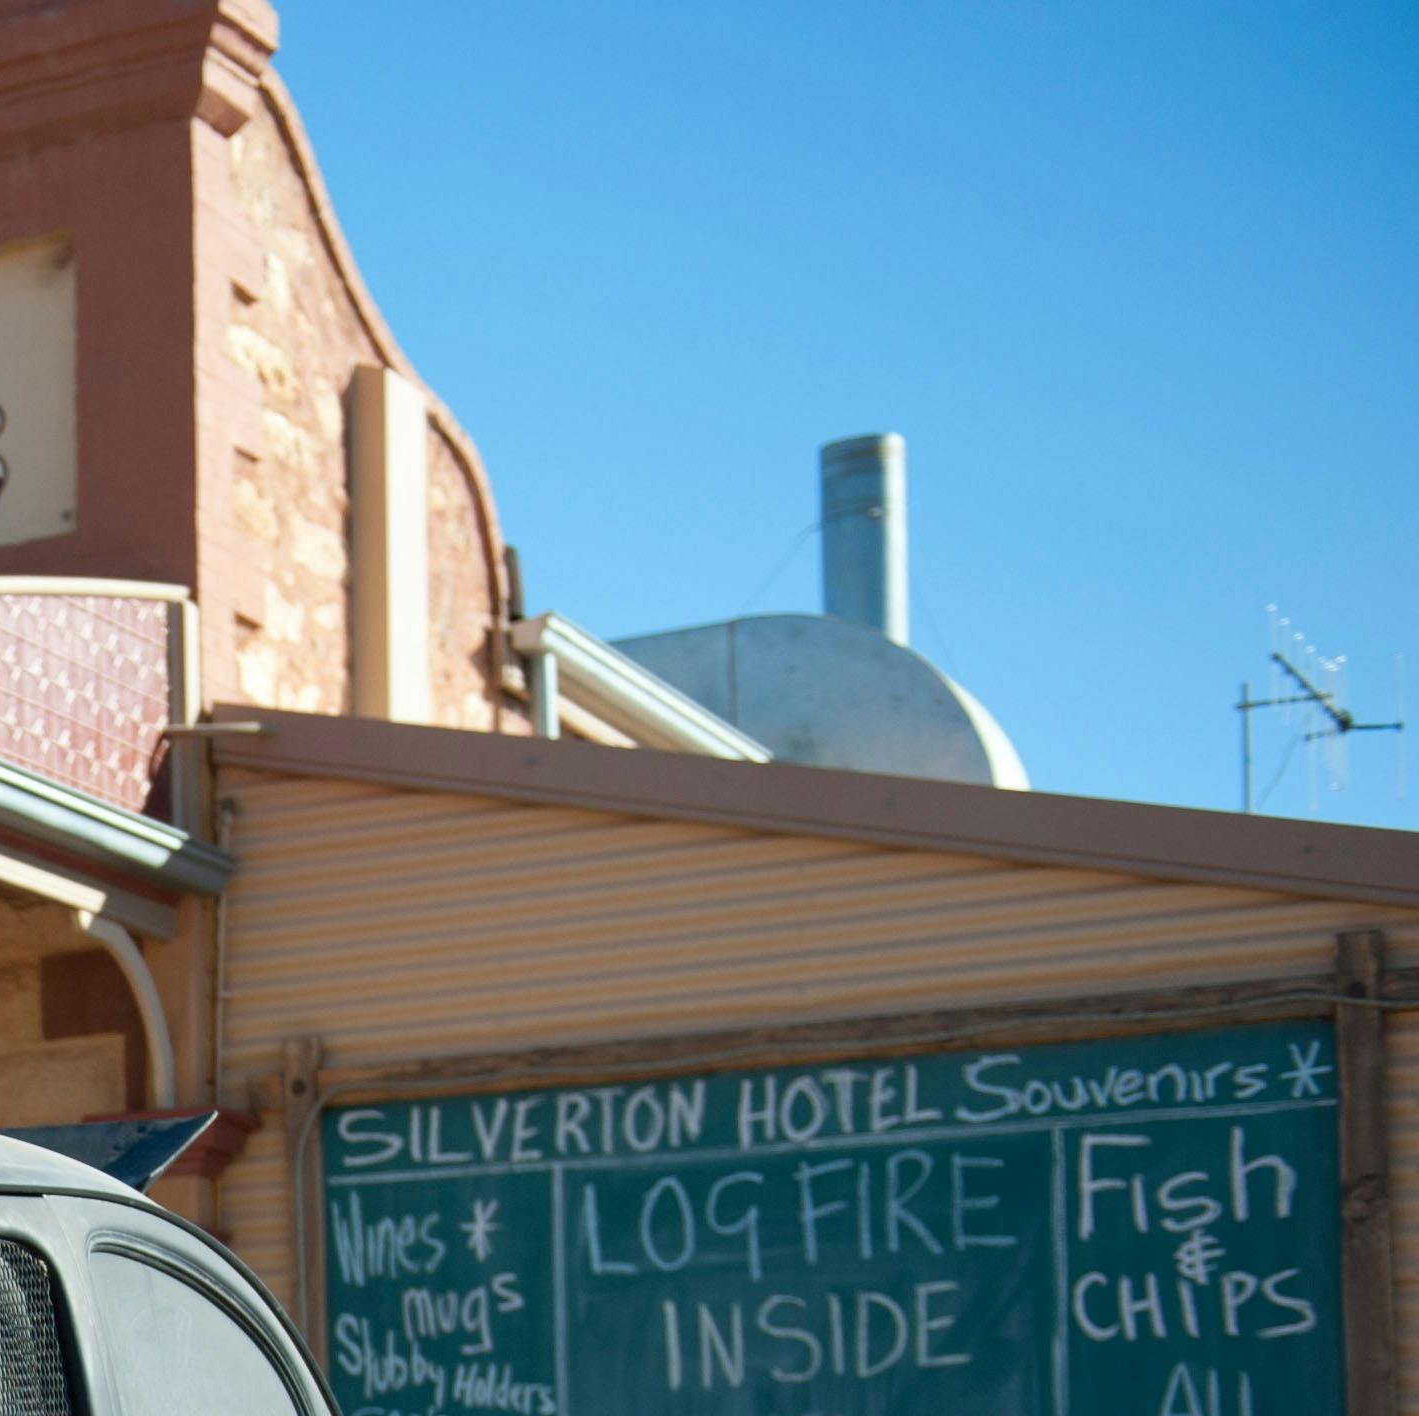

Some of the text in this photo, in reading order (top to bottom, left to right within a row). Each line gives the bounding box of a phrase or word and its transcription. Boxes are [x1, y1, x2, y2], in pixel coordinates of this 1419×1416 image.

[337, 1053, 1268, 1166] SILVERTON HOTEL Souvenirs
[332, 1189, 447, 1287] Wines
[794, 1149, 1017, 1265] FIRE
[1078, 1126, 1298, 1240] Fish
[662, 1279, 972, 1391] INSIDE
[1073, 1267, 1318, 1342] CHIPS
[454, 1362, 557, 1416] Holders
